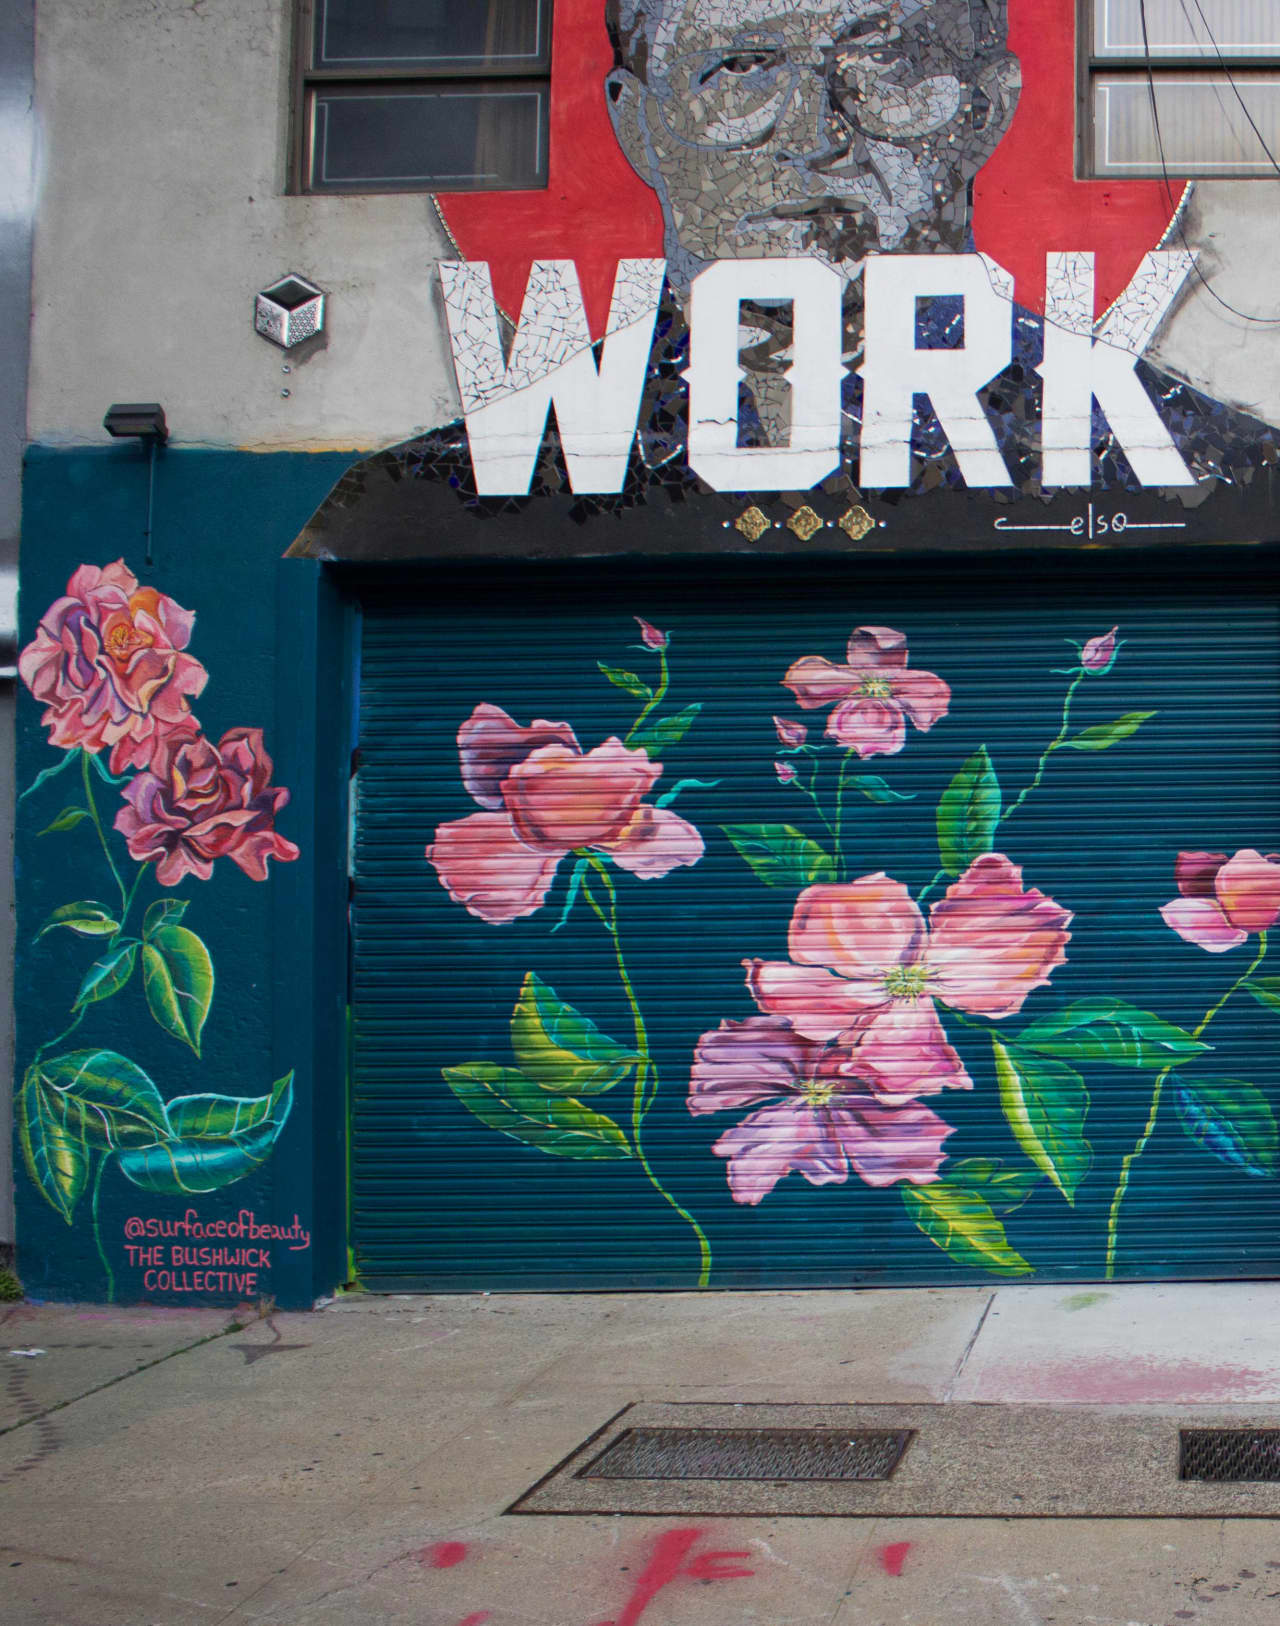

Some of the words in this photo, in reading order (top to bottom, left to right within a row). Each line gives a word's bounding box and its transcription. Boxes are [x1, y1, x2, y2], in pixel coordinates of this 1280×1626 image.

[438, 250, 1202, 496] WORK
[124, 1208, 311, 1251] @surfaceofbeauty
[123, 1244, 165, 1267] THE
[171, 1246, 272, 1269] BUSHWICK
[143, 1269, 257, 1296] COLLECTIVE
